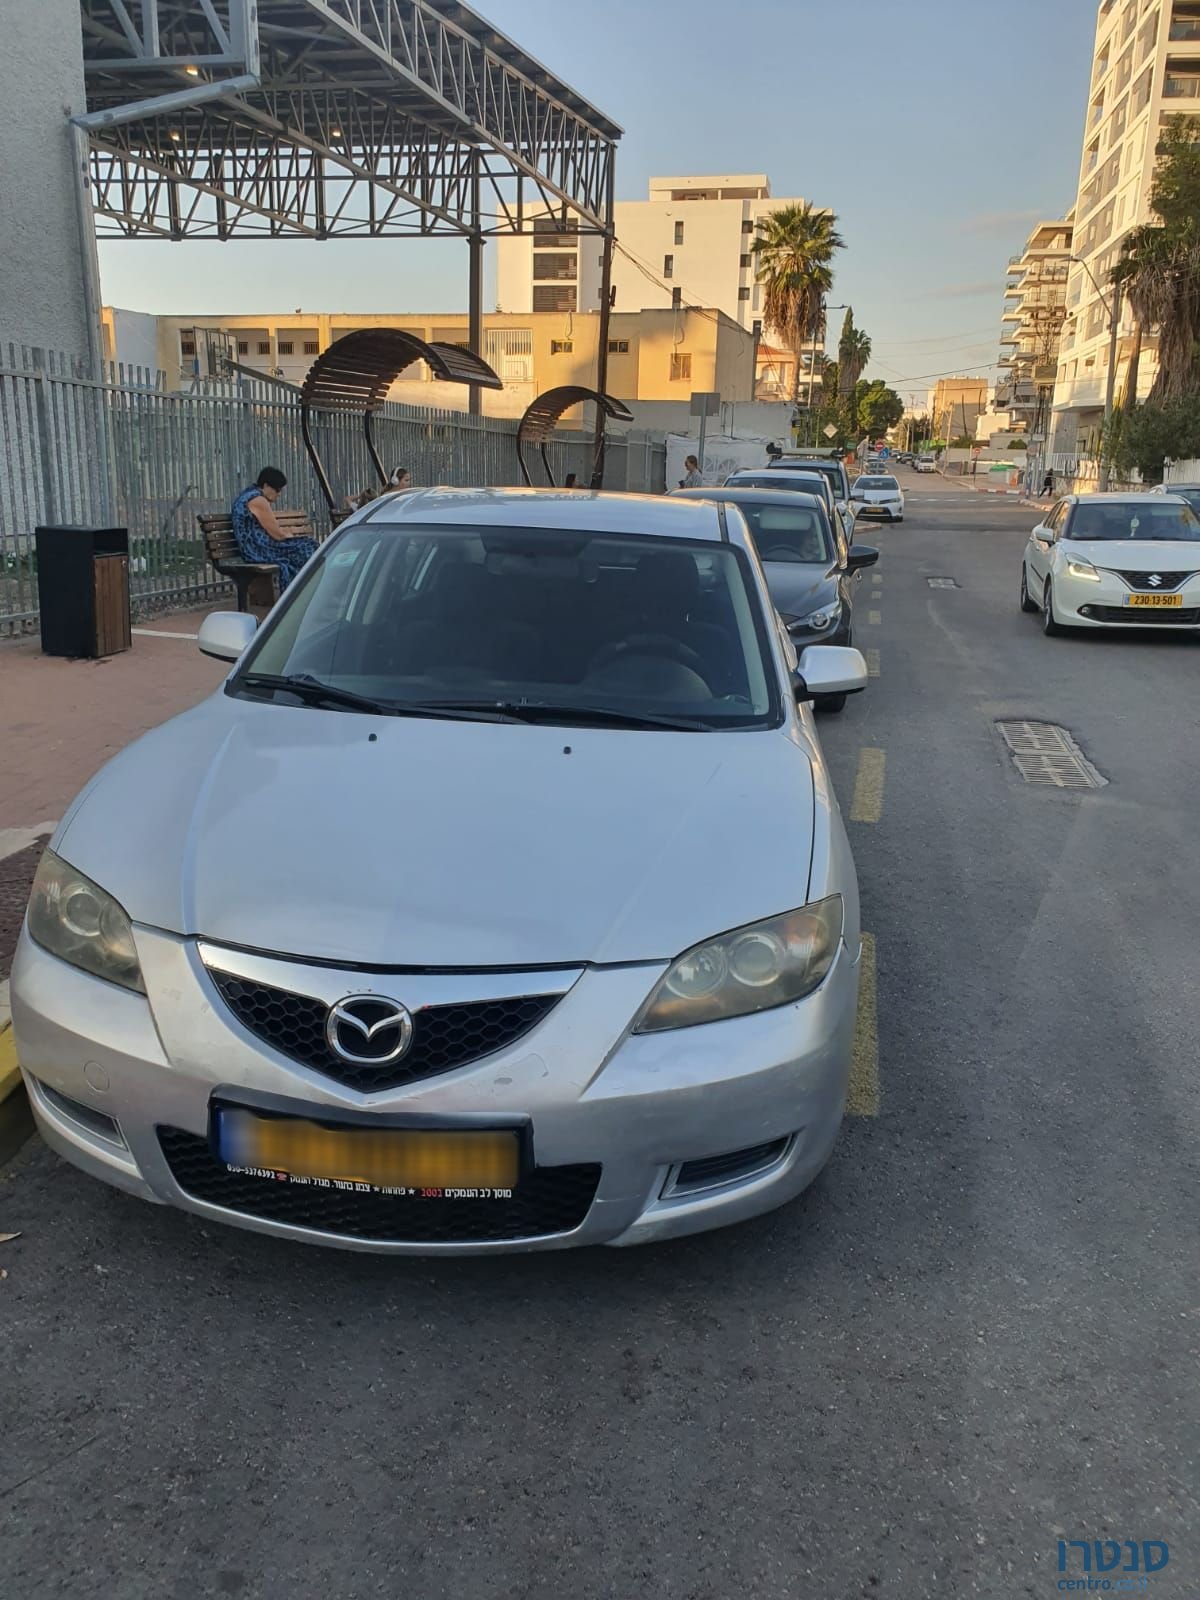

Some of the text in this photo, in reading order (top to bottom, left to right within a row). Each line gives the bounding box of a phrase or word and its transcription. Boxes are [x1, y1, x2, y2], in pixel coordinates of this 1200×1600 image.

[355, 1181, 371, 1192] צבע
[445, 1188, 478, 1199] העמקים
[480, 1187, 491, 1198] לב
[493, 1188, 512, 1199] מוסך
